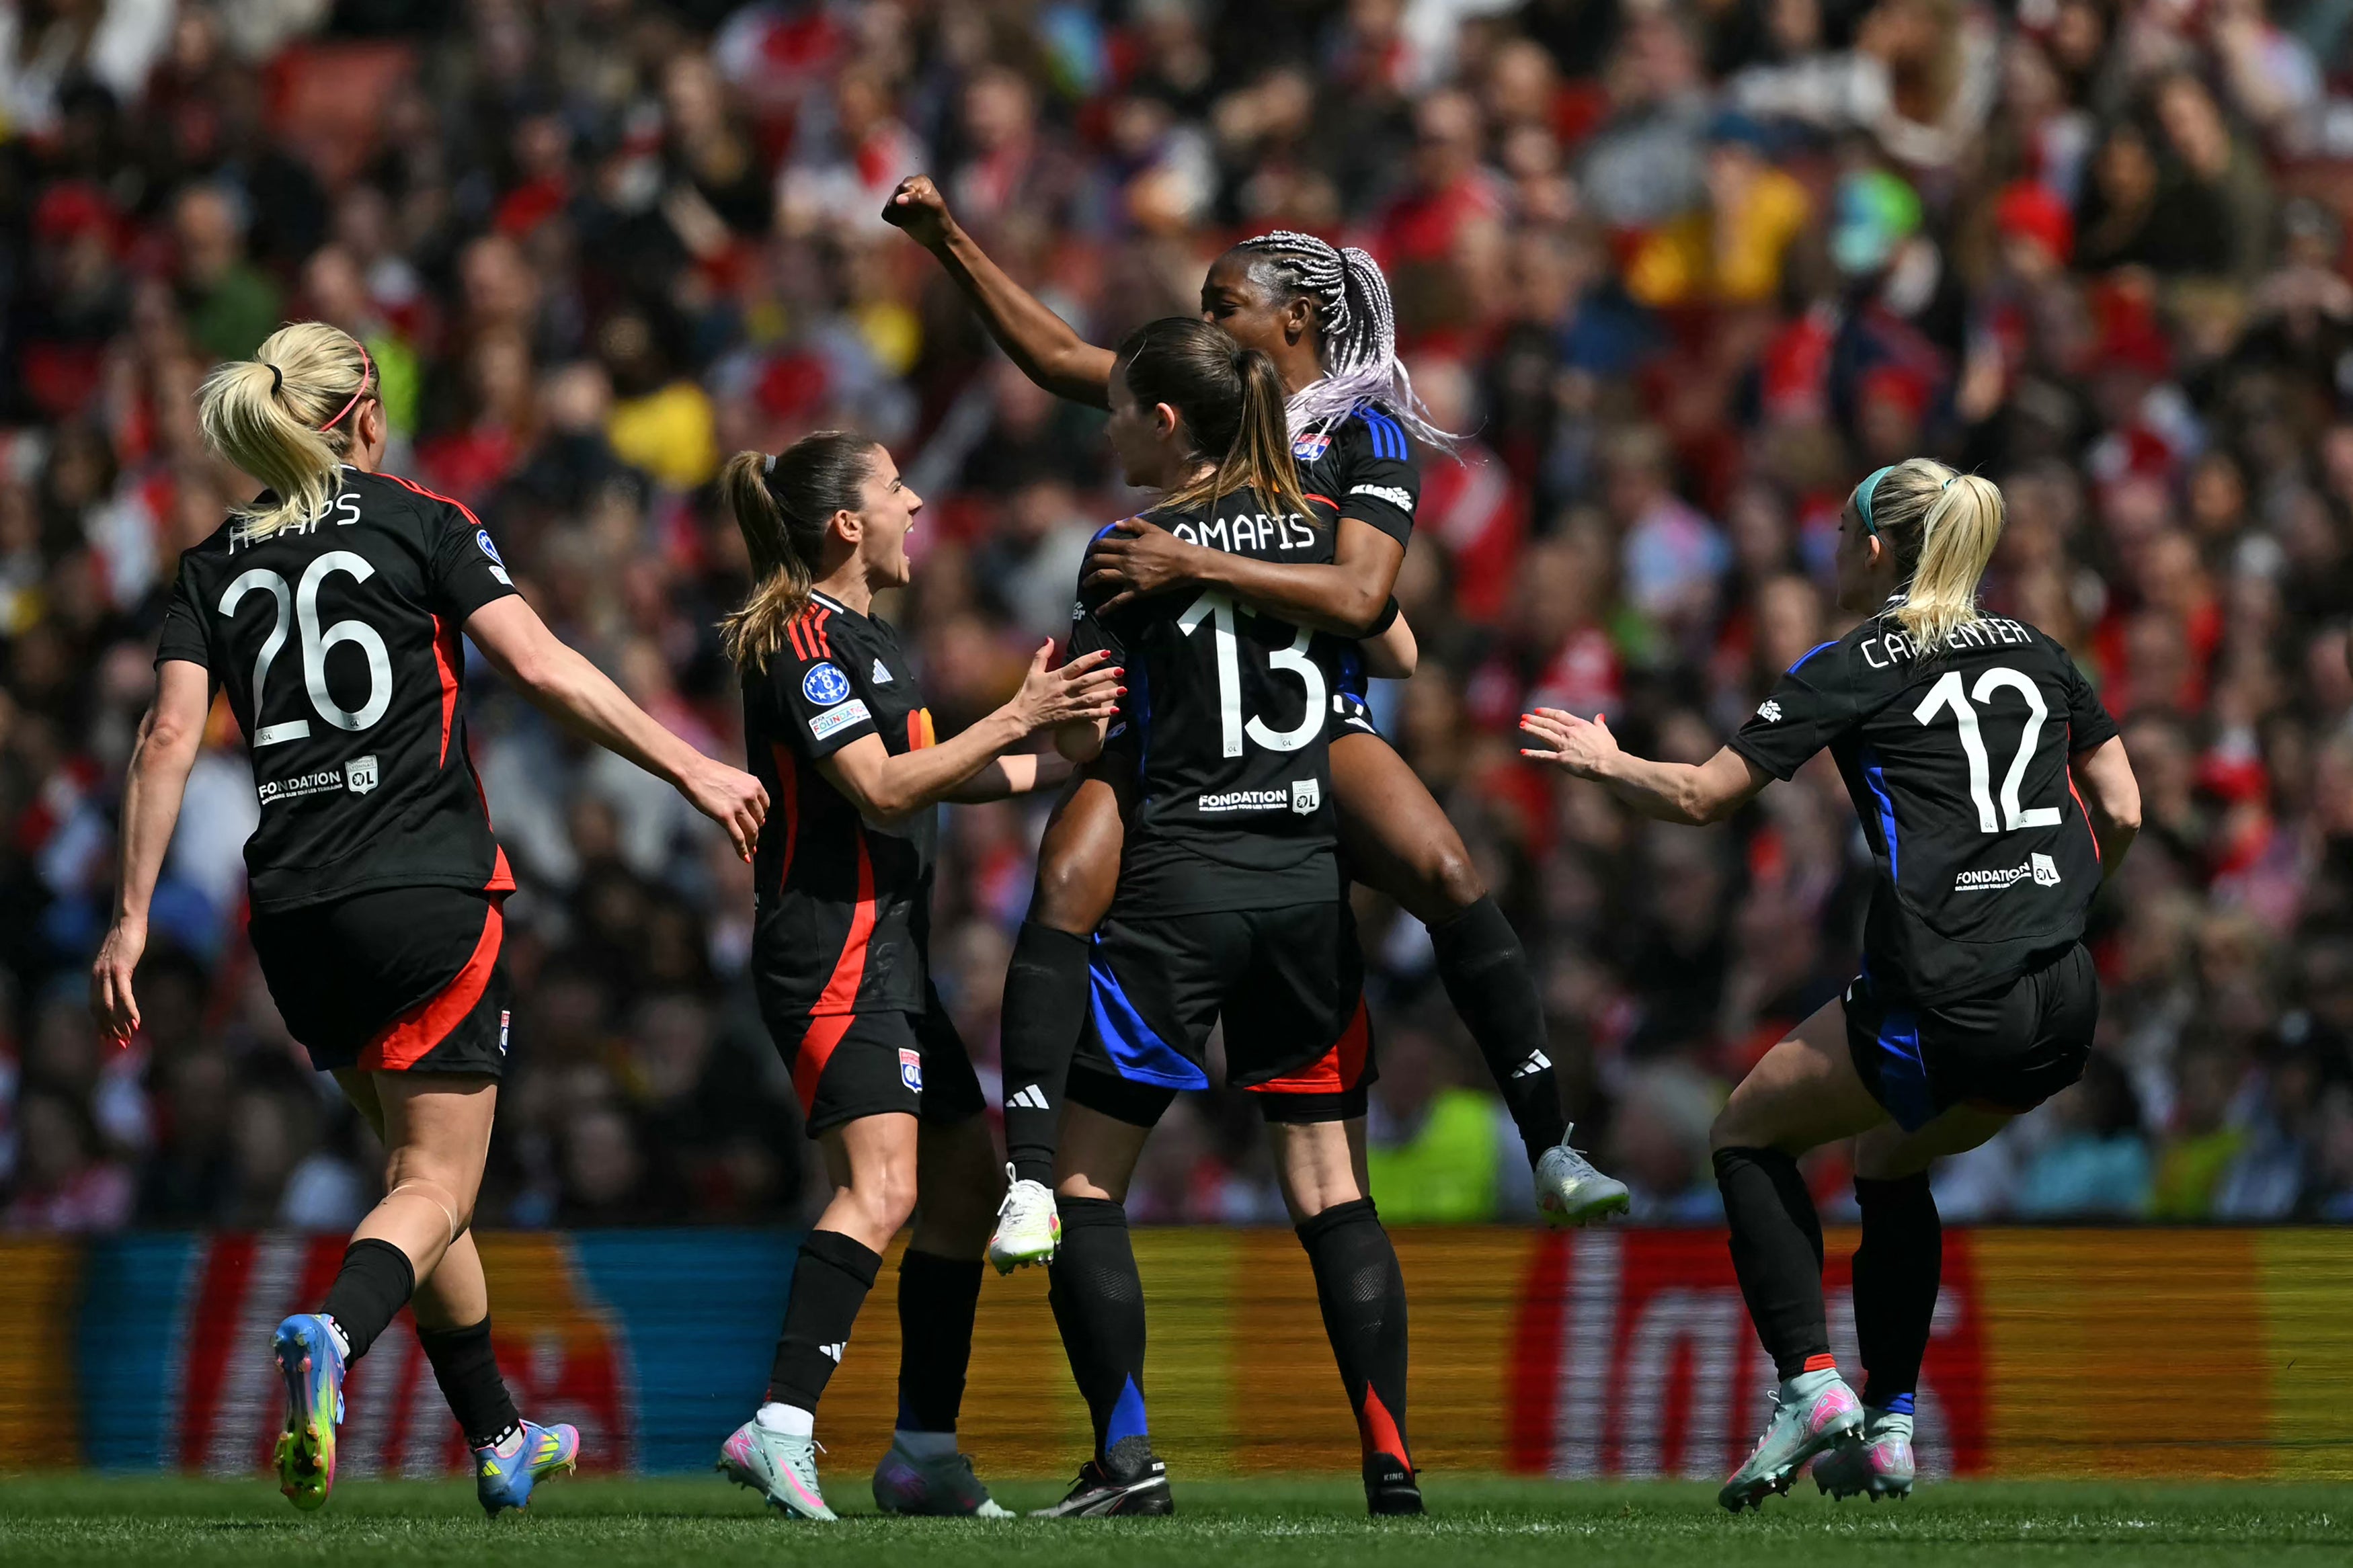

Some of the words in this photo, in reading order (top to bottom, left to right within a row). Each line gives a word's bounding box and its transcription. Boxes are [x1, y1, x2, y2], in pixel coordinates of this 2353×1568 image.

[218, 550, 393, 747] 26
[1860, 618, 2032, 667] CARENTER
[822, 675, 834, 690] 8
[1176, 589, 1326, 757] 13
[1913, 667, 2062, 832] 12
[259, 771, 341, 798] FONDATION
[352, 771, 374, 786] OL
[1199, 789, 1287, 806] FONDATION
[1297, 795, 1315, 809] OL
[1956, 862, 2030, 884] FONDATION
[2036, 868, 2056, 880] OL
[1384, 1472, 1403, 1481] KING
